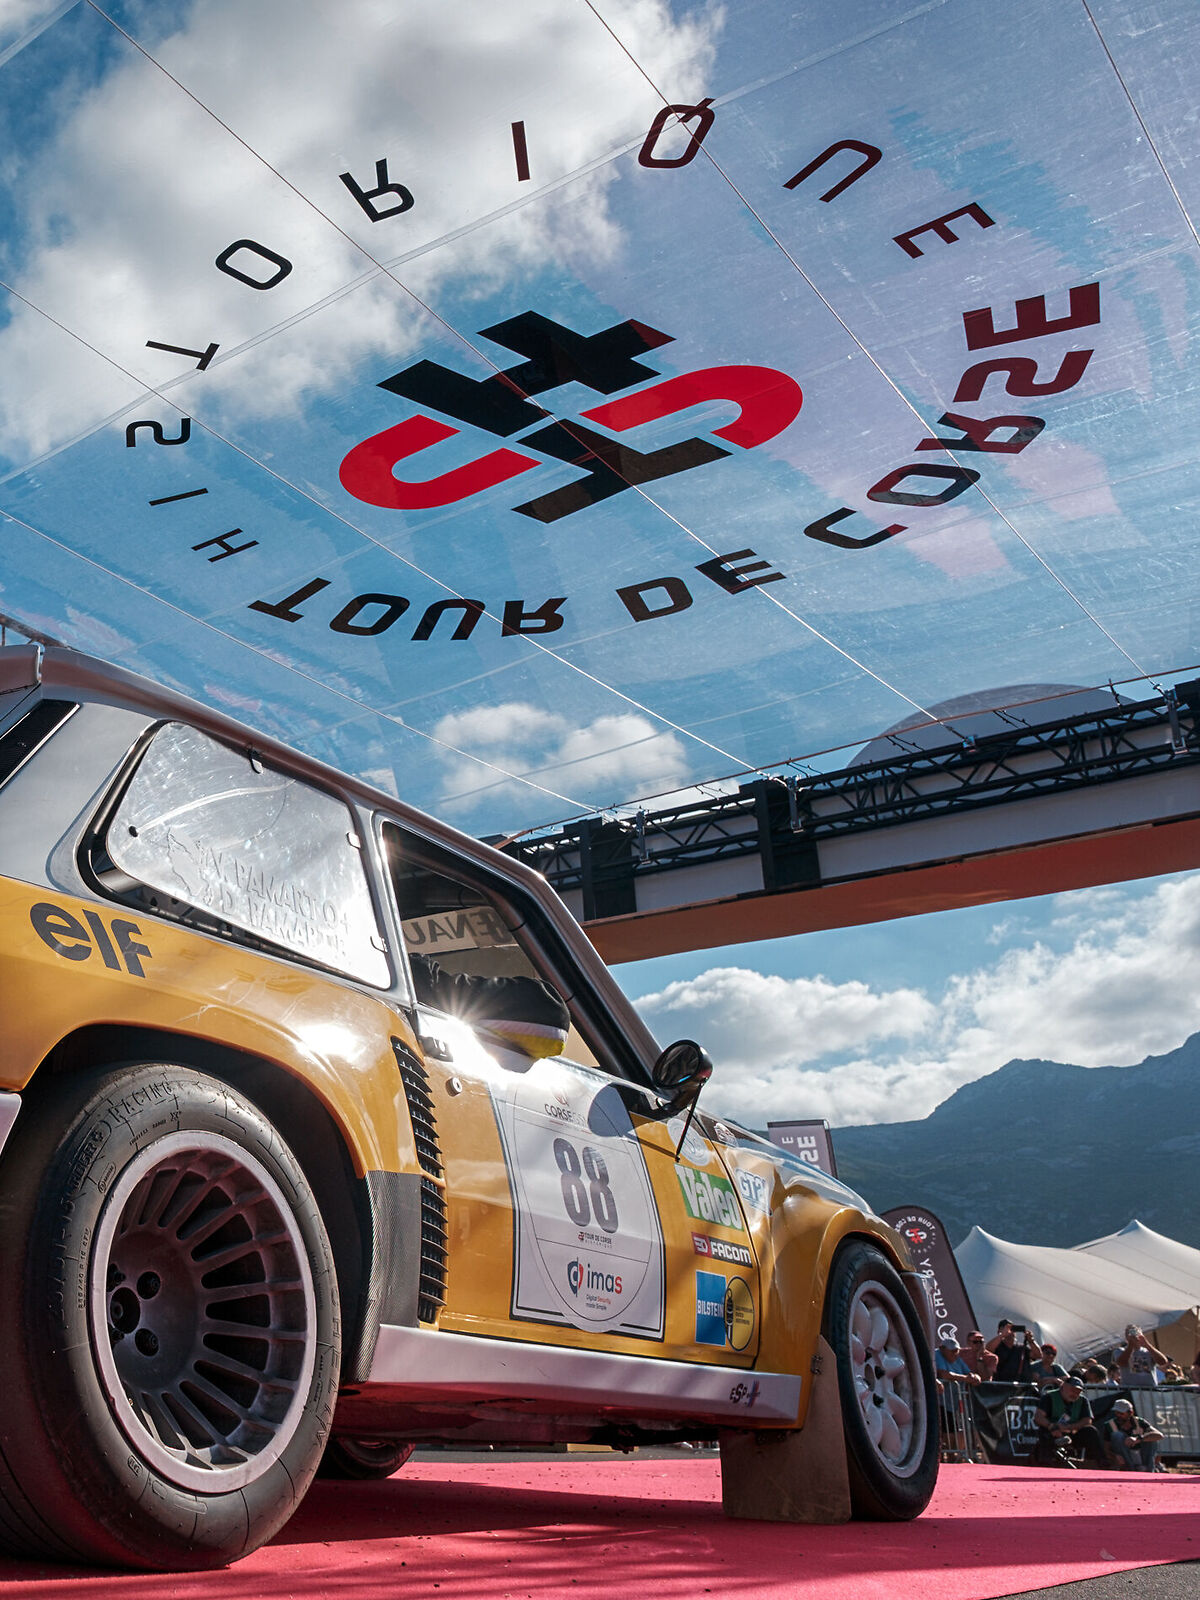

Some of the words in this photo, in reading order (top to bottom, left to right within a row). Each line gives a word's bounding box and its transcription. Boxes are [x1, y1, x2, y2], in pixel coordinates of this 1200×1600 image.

[30, 902, 152, 978] elf
[553, 1138, 619, 1233] 88
[674, 1163, 743, 1230] Valeo
[710, 1241, 752, 1264] FACOM
[587, 1263, 623, 1294] imas
[697, 1300, 725, 1318] BILSTEIN
